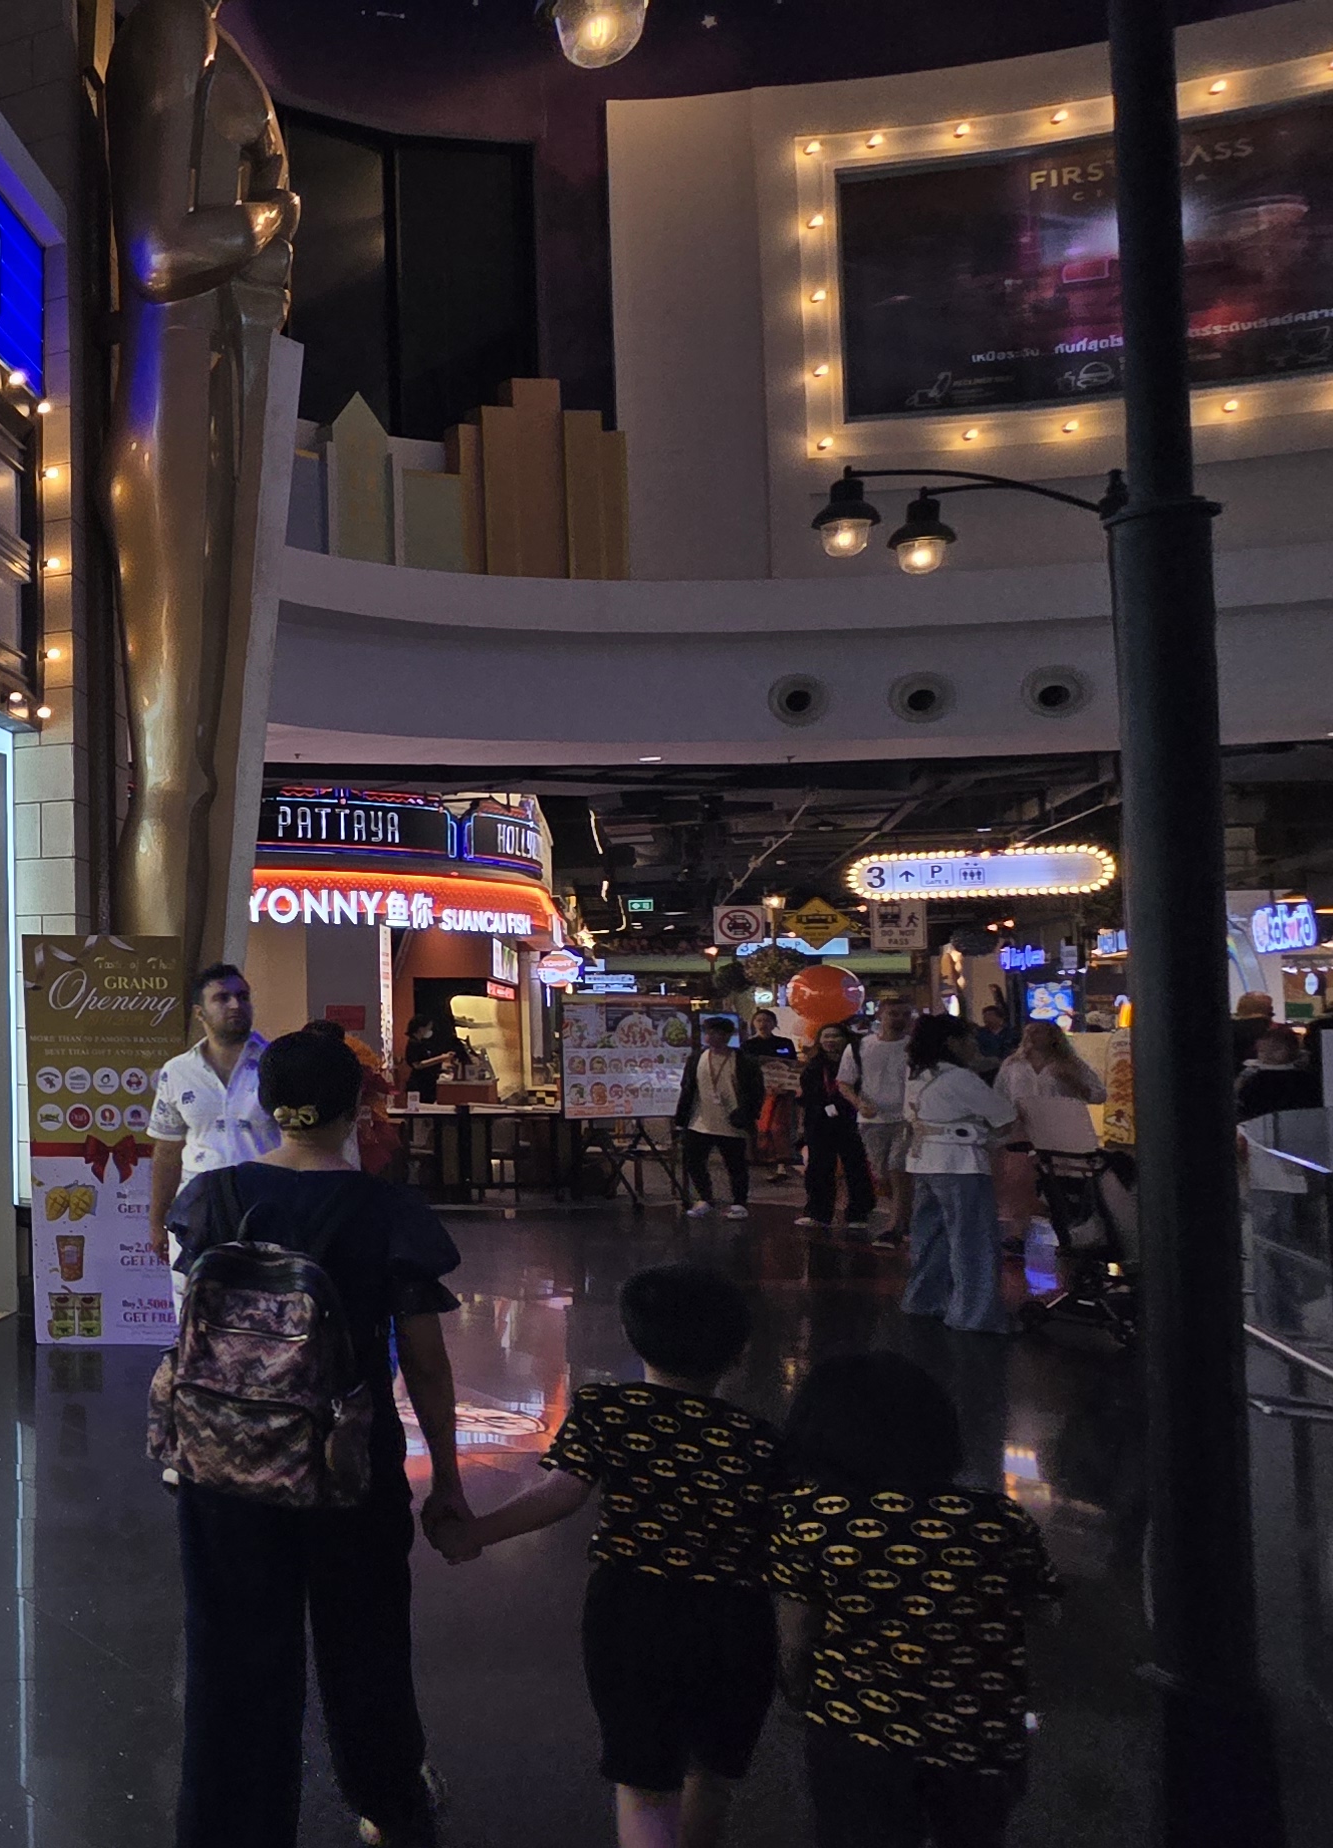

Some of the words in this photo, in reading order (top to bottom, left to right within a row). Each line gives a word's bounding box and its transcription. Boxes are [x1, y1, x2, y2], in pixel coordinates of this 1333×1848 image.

[277, 805, 400, 844] PATTAYA
[866, 866, 886, 889] 3
[930, 865, 943, 879] P
[249, 886, 383, 926] YONNY
[385, 890, 434, 930] 鱼你
[439, 908, 506, 934] SUANCAI
[507, 911, 532, 936] FISH
[104, 976, 169, 990] GRAND
[49, 968, 180, 1027] Opening
[117, 1203, 142, 1214] GET
[120, 1255, 146, 1266] GET
[123, 1312, 148, 1323] GET
[151, 1312, 176, 1323] FRE
